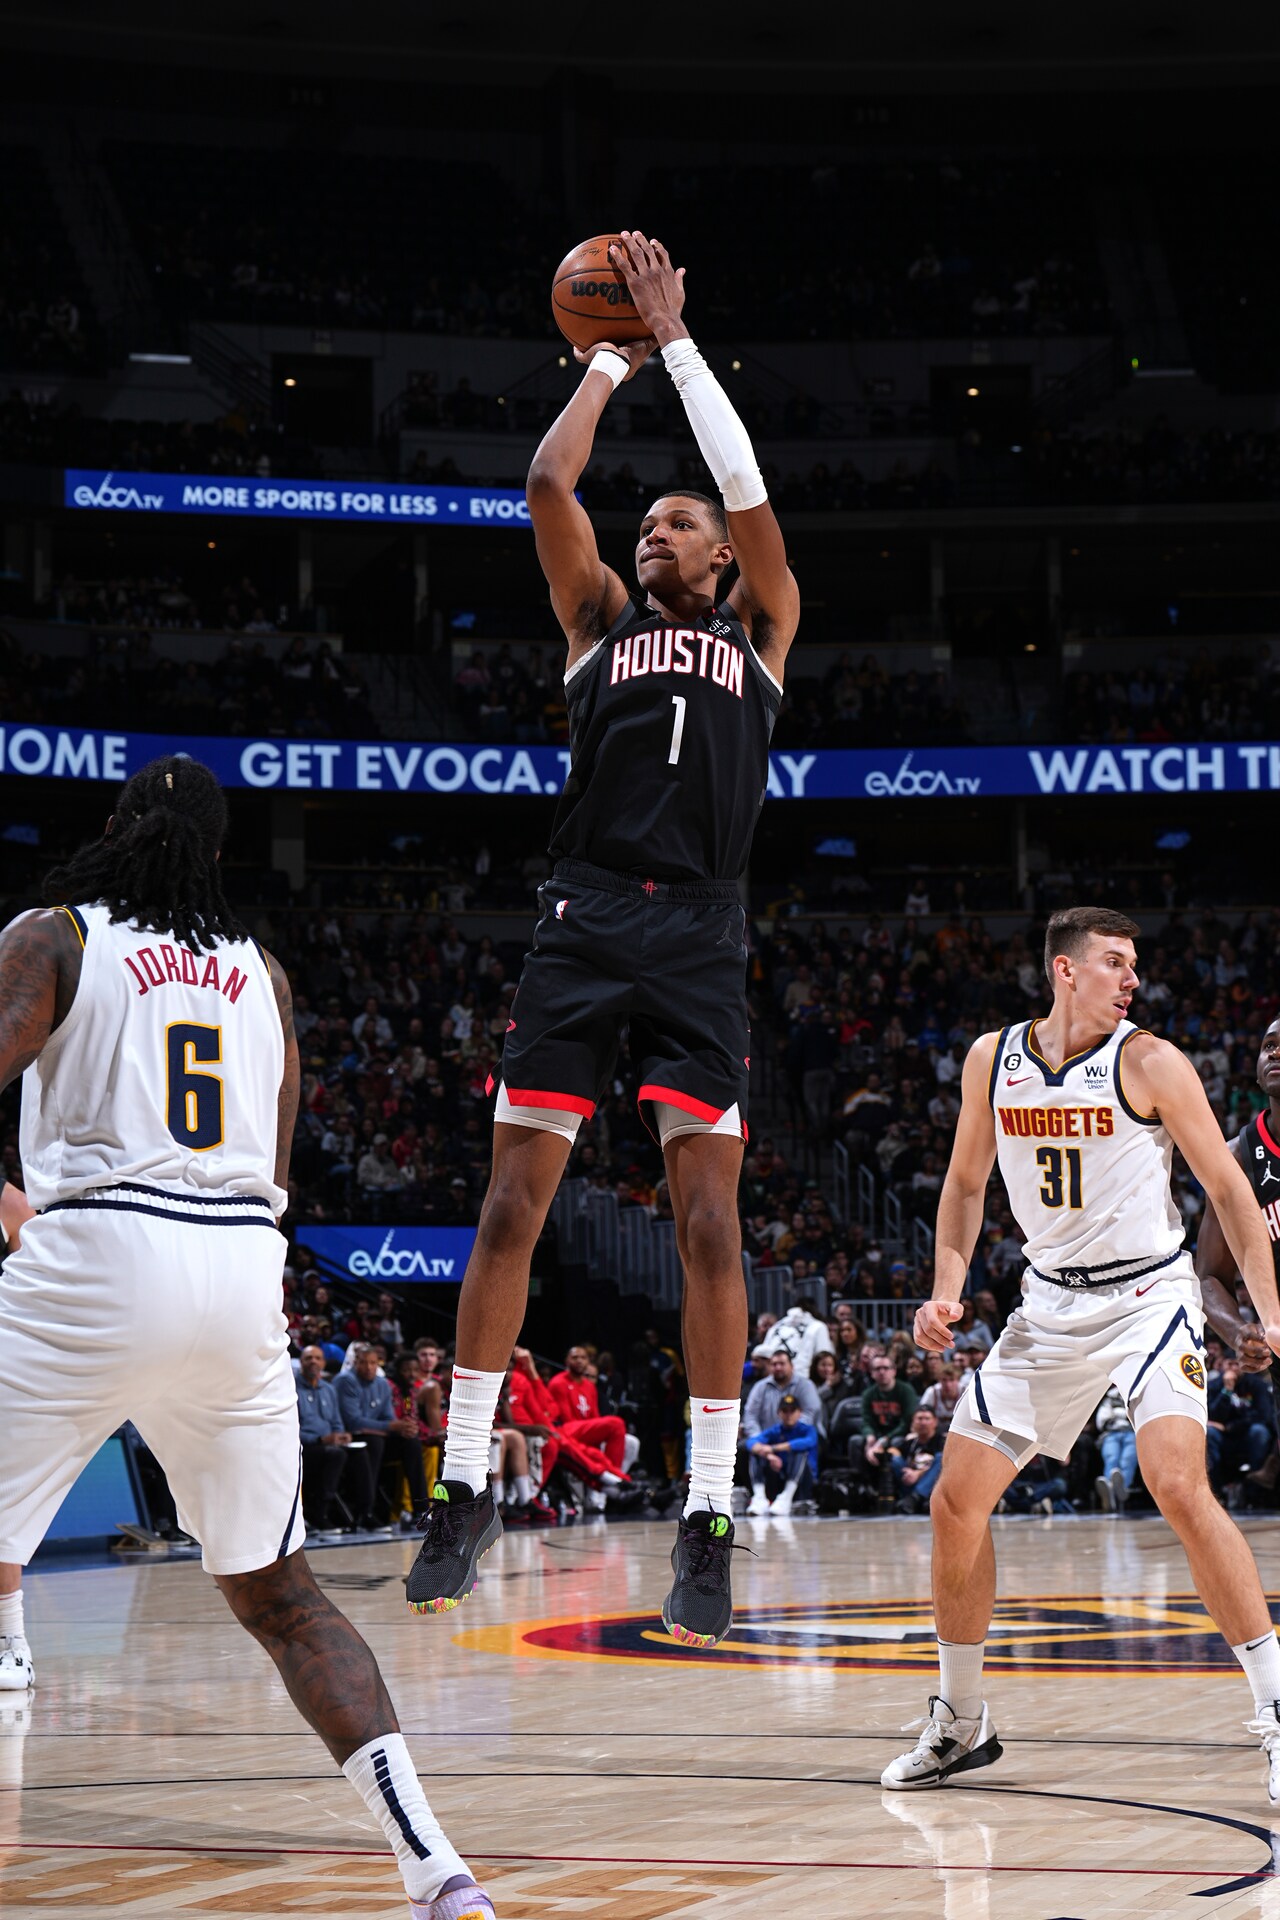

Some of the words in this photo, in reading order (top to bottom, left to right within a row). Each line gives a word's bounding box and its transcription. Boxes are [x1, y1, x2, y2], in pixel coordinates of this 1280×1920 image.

[571, 281, 635, 306] ilson
[182, 485, 249, 508] MORE
[254, 488, 337, 512] SPORTS
[341, 492, 385, 513] FOR
[390, 494, 438, 516] LESS
[609, 629, 744, 699] HOUSTON
[667, 695, 687, 765] 1
[0, 726, 127, 781] OME
[239, 742, 341, 788] GET
[1028, 747, 1225, 794] WATCH
[1237, 745, 1280, 790] T
[124, 944, 248, 1004] JORDAN
[1005, 1054, 1021, 1070] 6
[1084, 1065, 1108, 1078] WU
[165, 1021, 224, 1153] 6
[998, 1107, 1114, 1138] NUGGETS
[1255, 1145, 1265, 1160] 6
[1036, 1145, 1084, 1209] 31
